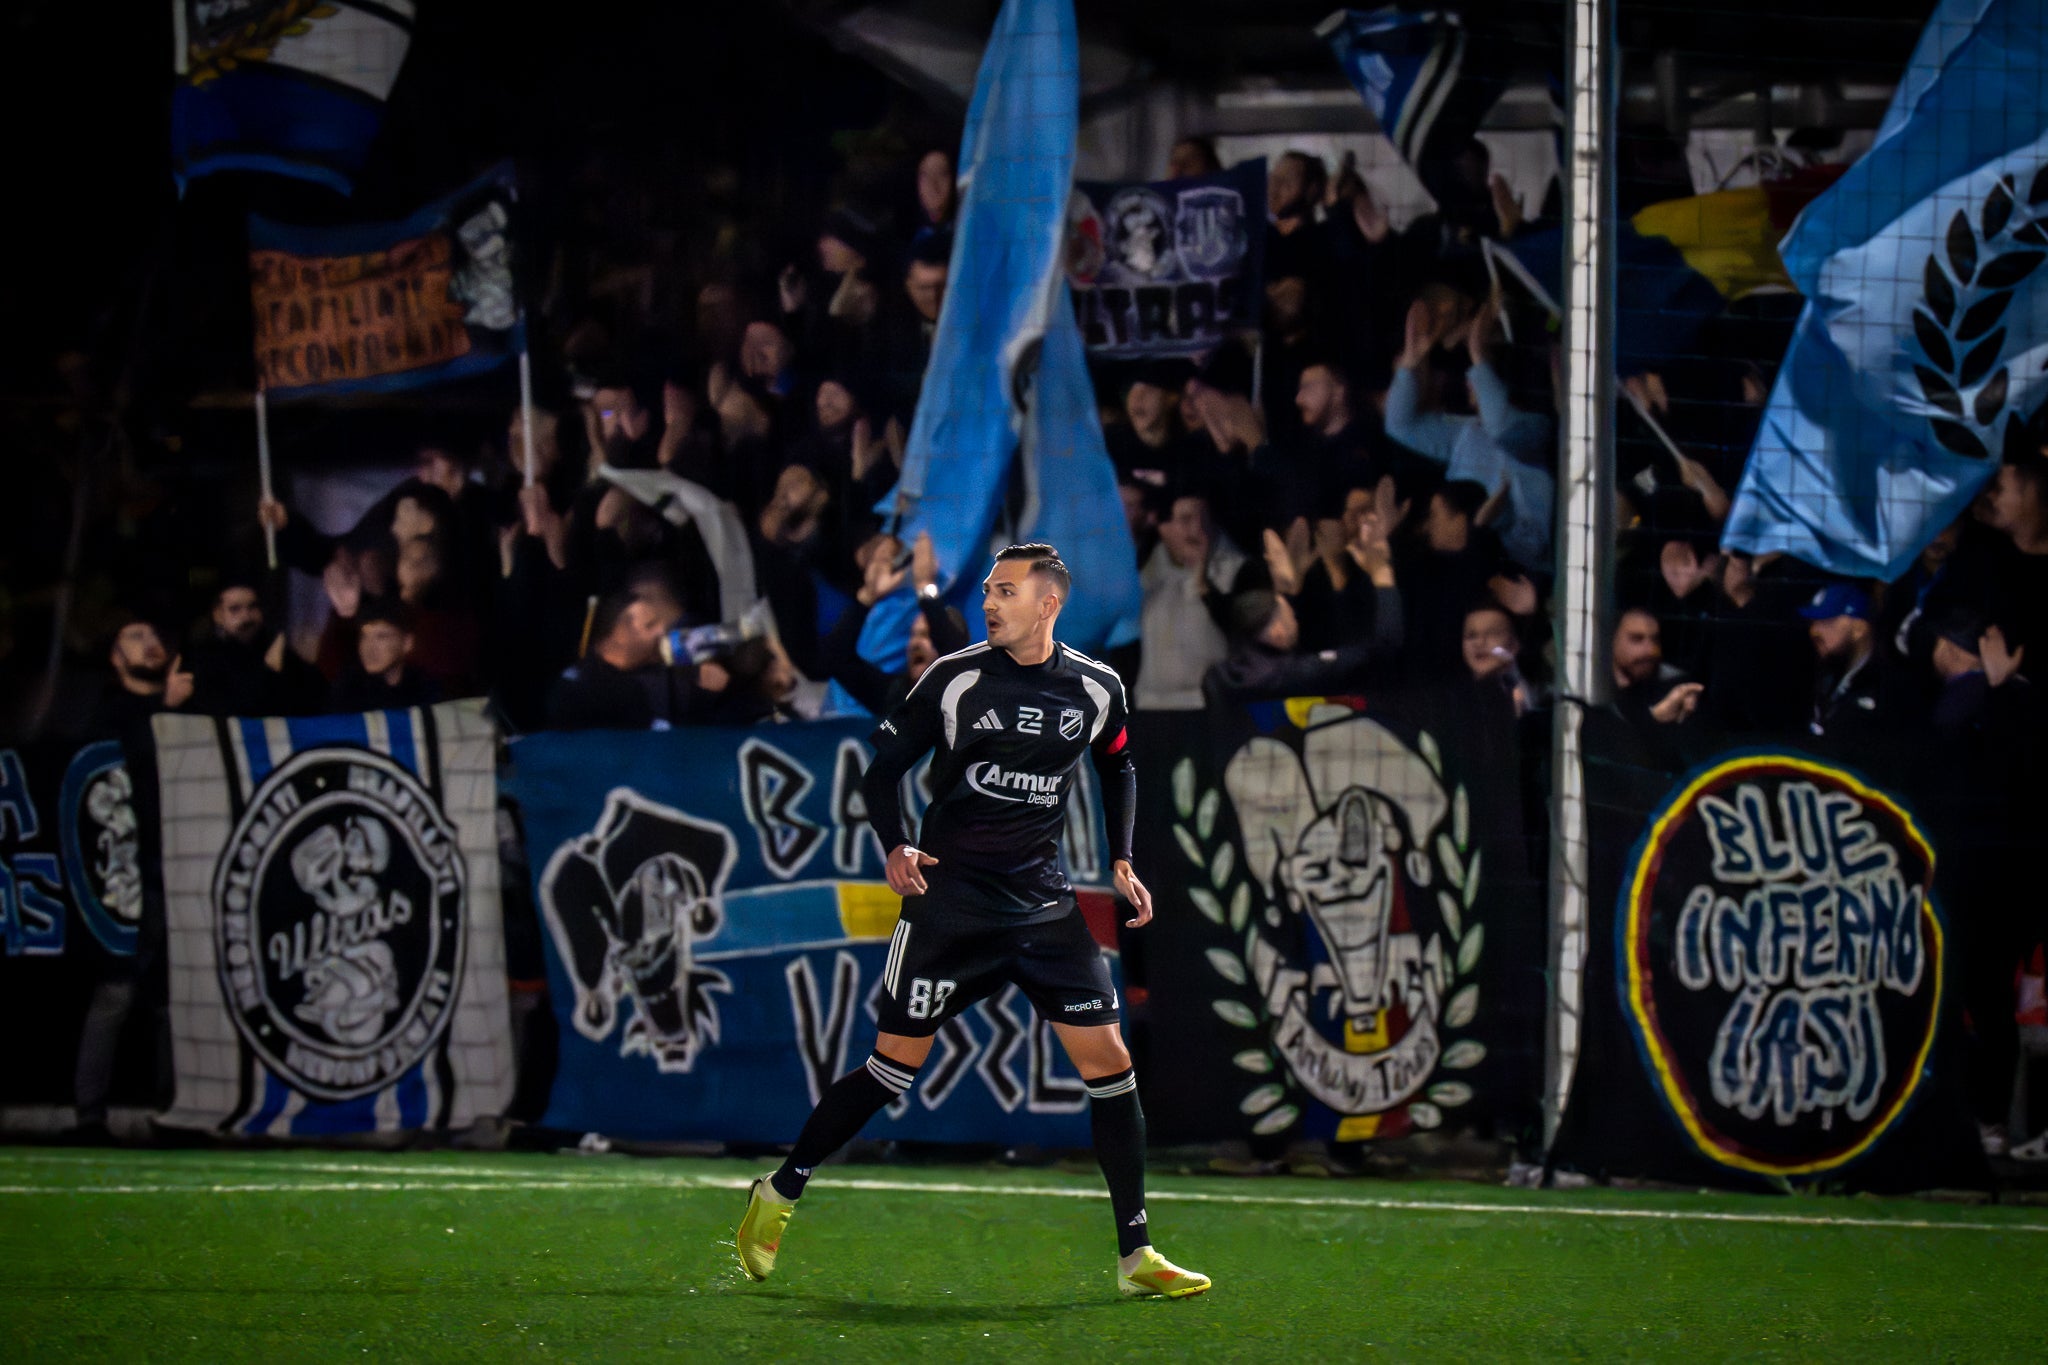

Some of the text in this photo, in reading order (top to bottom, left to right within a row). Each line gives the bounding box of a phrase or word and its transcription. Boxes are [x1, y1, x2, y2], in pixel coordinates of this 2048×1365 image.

[980, 764, 1063, 792] Armur
[1027, 792, 1059, 807] Design
[1697, 782, 1899, 883] BLUE
[268, 889, 413, 982] Ultras
[1676, 868, 1926, 997] INFERNO
[1064, 1002, 1092, 1012] ZECRO
